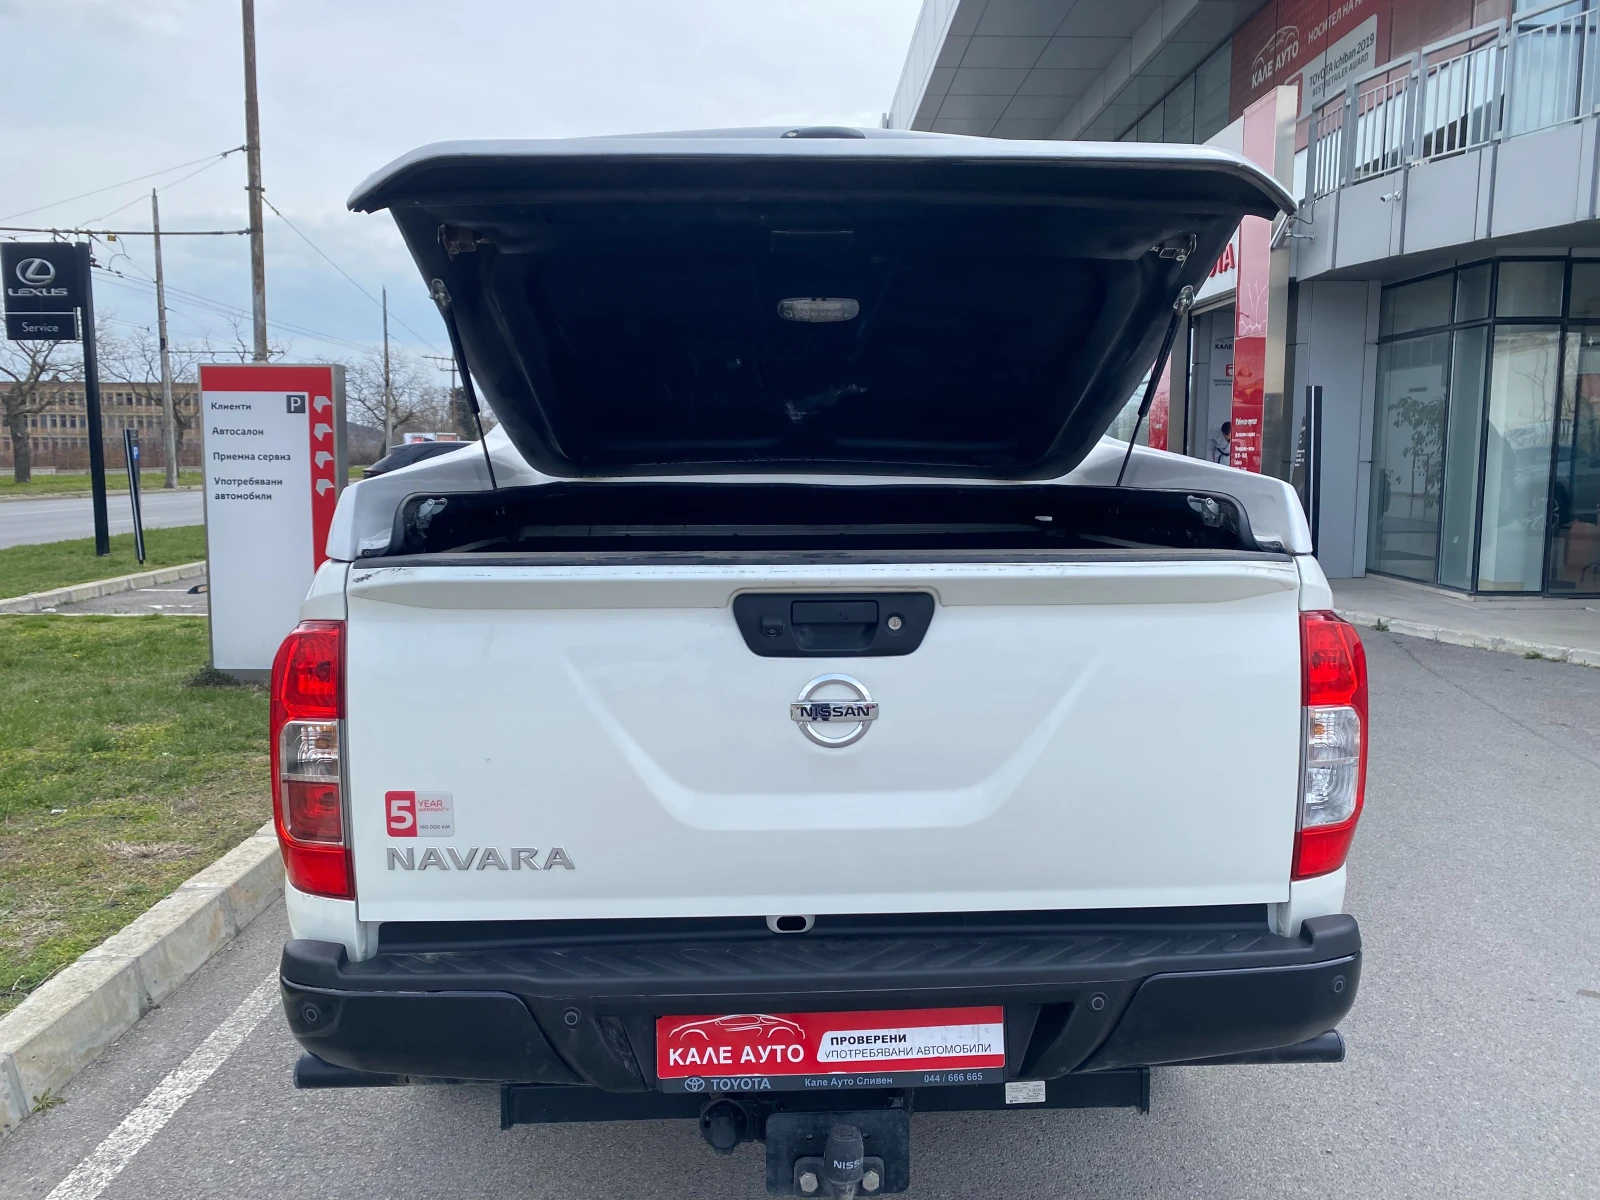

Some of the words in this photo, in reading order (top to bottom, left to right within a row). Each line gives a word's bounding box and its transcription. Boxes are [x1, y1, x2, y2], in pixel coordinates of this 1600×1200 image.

[1308, 7, 1341, 44] НОСИТЕЛ
[1342, 0, 1353, 18] НА
[1251, 60, 1273, 89] КАЛЕ
[1275, 40, 1299, 72] АУТО
[1309, 62, 1334, 88] TOYOTA
[1333, 49, 1356, 71] Ichiban
[1356, 32, 1375, 55] 2019
[1312, 81, 1324, 97] BEST
[1324, 64, 1348, 90] RETAILER
[1348, 52, 1369, 72] AWARD
[7, 287, 69, 297] LEXUS
[21, 321, 59, 333] Service
[210, 402, 252, 411] Клиенти
[290, 396, 302, 412] P
[211, 426, 264, 436] Автосалон
[212, 452, 256, 463] Приемна
[257, 454, 291, 463] сервиз
[213, 476, 283, 488] Употребявани
[214, 491, 272, 501] автомобили
[799, 705, 871, 718] NISSAN
[417, 799, 443, 808] YEAR
[390, 799, 414, 830] 5
[386, 845, 576, 871] NAVARA
[830, 1033, 907, 1046] ПРОВЕРЕНИ
[668, 1046, 733, 1067] КАЛЕ
[739, 1044, 805, 1064] АУТО
[824, 1046, 914, 1060] УПОТРЕБЯВАНИ
[916, 1043, 992, 1056] АВТОМОБИЛИ
[804, 1078, 828, 1087] Кале
[830, 1077, 854, 1088] Ауто
[856, 1075, 893, 1086] Сливен
[923, 1074, 941, 1083] 044
[948, 1073, 965, 1082] 666
[966, 1072, 983, 1081] 665
[710, 1078, 772, 1091] TOYOTA
